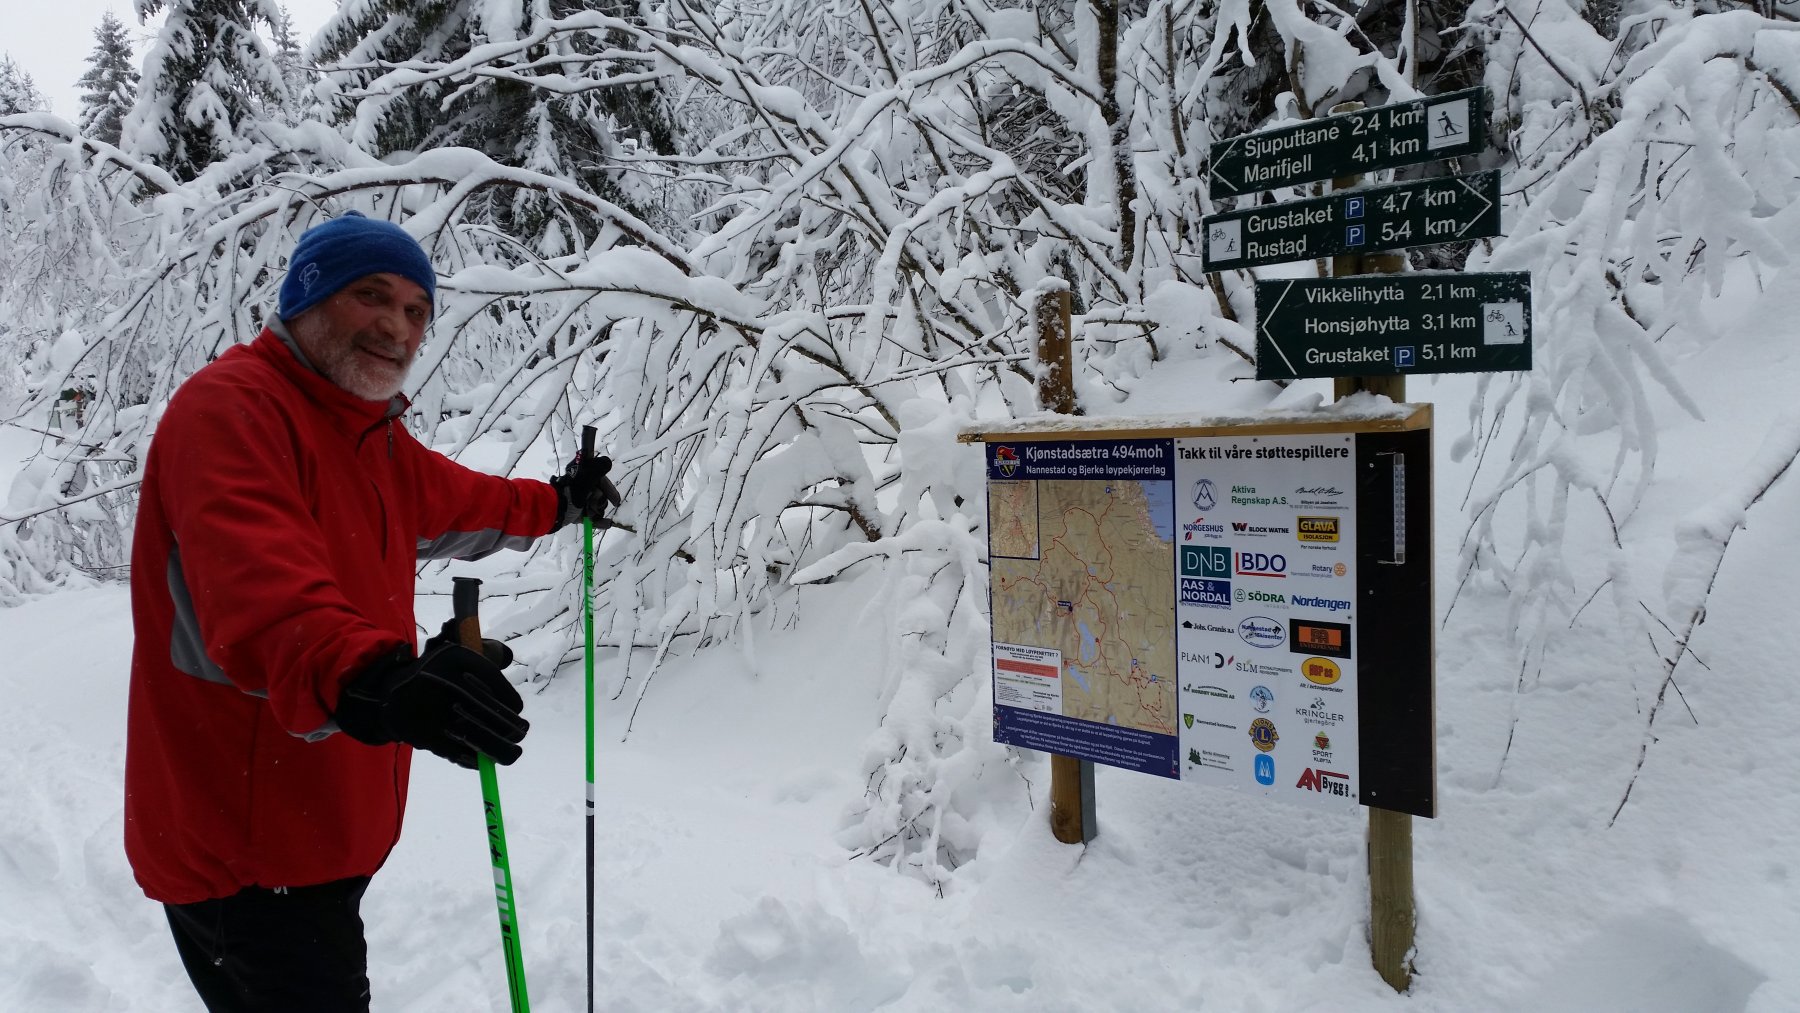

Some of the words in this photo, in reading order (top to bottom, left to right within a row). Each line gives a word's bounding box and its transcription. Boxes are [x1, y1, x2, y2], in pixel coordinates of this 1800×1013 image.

[1244, 124, 1340, 161] Sjuputtane
[1351, 113, 1380, 136] 2,4
[1390, 108, 1420, 129] km
[1244, 155, 1312, 184] Marifjell
[1352, 143, 1377, 163] 4,1
[1390, 138, 1420, 156] km
[1248, 205, 1333, 234] Grustaket
[1349, 200, 1361, 216] P
[1382, 192, 1412, 215] 4,7
[1424, 187, 1456, 207] km
[1247, 236, 1307, 260] Rustad
[1350, 228, 1361, 243] P
[1381, 221, 1412, 243] 5,4
[1426, 216, 1456, 236] km
[1305, 287, 1404, 306] Vikkelihytta
[1421, 283, 1444, 302] 2,1
[1450, 284, 1476, 299] km
[1305, 317, 1410, 336] Honsjøhytta
[1421, 314, 1444, 331] 3,1
[1450, 314, 1476, 329] km
[1305, 348, 1390, 365] Grustaket
[1399, 349, 1411, 364] P
[1422, 344, 1444, 361] 5,1
[1450, 344, 1476, 359] km
[1026, 444, 1109, 462] Kjønstadsætra
[1112, 445, 1163, 459] 494moh
[1178, 447, 1205, 460] Takk
[1209, 447, 1221, 459] til
[1225, 445, 1252, 459] våre
[1256, 445, 1349, 461] støttespillere
[1026, 465, 1065, 474] Nannestad
[1067, 467, 1077, 477] og
[1079, 465, 1104, 476] Bjerke
[1106, 465, 1166, 477] løypekjørerlag
[1232, 485, 1256, 494] Aktiva
[1232, 496, 1271, 506] Regnskap
[1272, 497, 1288, 505] A.S.
[1183, 524, 1223, 533] NORGESHUS
[1300, 521, 1336, 532] GLAVA
[1187, 551, 1226, 575] DNB
[1242, 552, 1287, 573] BDO
[1312, 564, 1333, 574] Rotary
[1183, 580, 1204, 590] AAS
[1207, 582, 1215, 591] &
[1183, 591, 1230, 603] NORDAL
[1248, 590, 1285, 603] SÖDRA
[1291, 595, 1351, 612] Nordengen
[1236, 662, 1258, 673] SLM
[1296, 708, 1345, 722] KRINGLER
[1255, 718, 1273, 730] LIONS
[1261, 729, 1268, 741] L
[1312, 749, 1333, 759] SPORT
[1296, 768, 1321, 793] AN
[1323, 777, 1343, 797] Bygg
